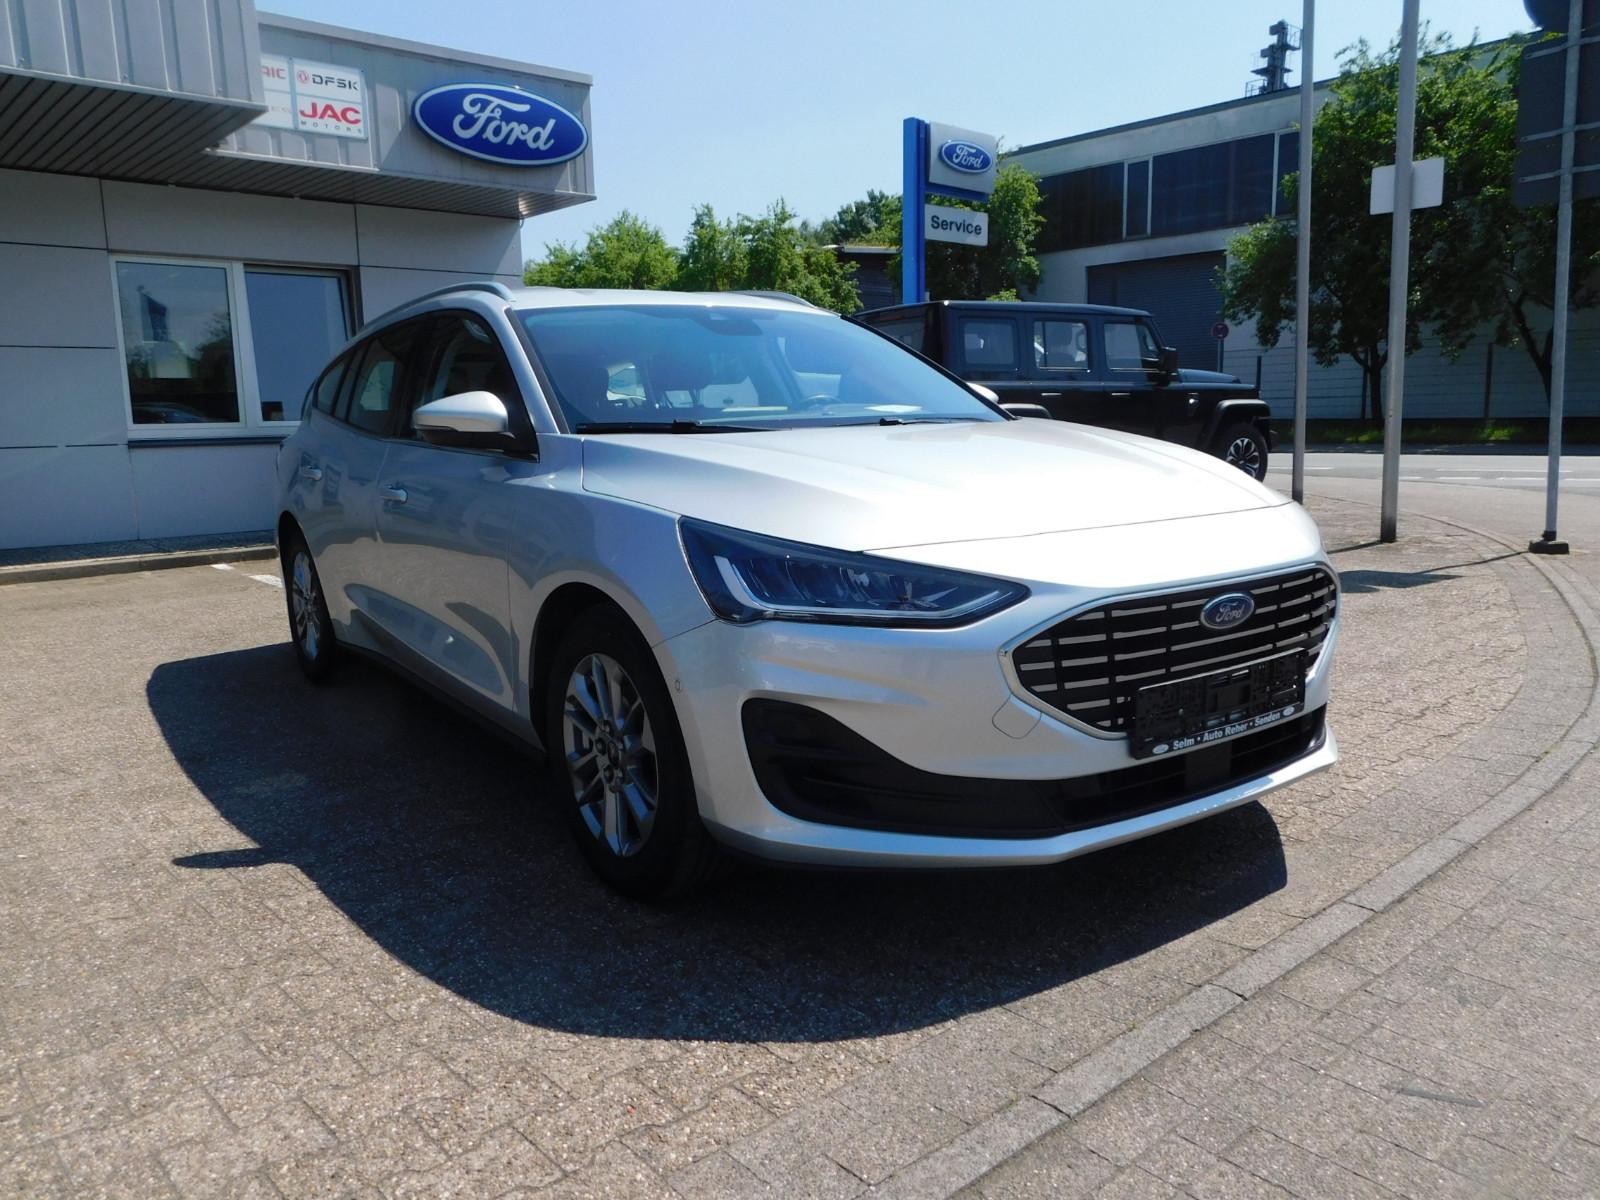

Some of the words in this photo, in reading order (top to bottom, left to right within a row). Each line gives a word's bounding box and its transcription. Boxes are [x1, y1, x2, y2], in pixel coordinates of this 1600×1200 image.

[311, 73, 359, 91] DFSK
[299, 101, 362, 125] JAC
[453, 93, 556, 151] Ford
[300, 121, 362, 134] MOTORS
[952, 144, 984, 169] Ford
[930, 215, 982, 235] Service
[1215, 601, 1245, 623] Ford
[1172, 736, 1195, 751] Selm
[1202, 730, 1223, 742] Auto
[1224, 723, 1248, 737] Reher
[1254, 711, 1281, 727] Senden
